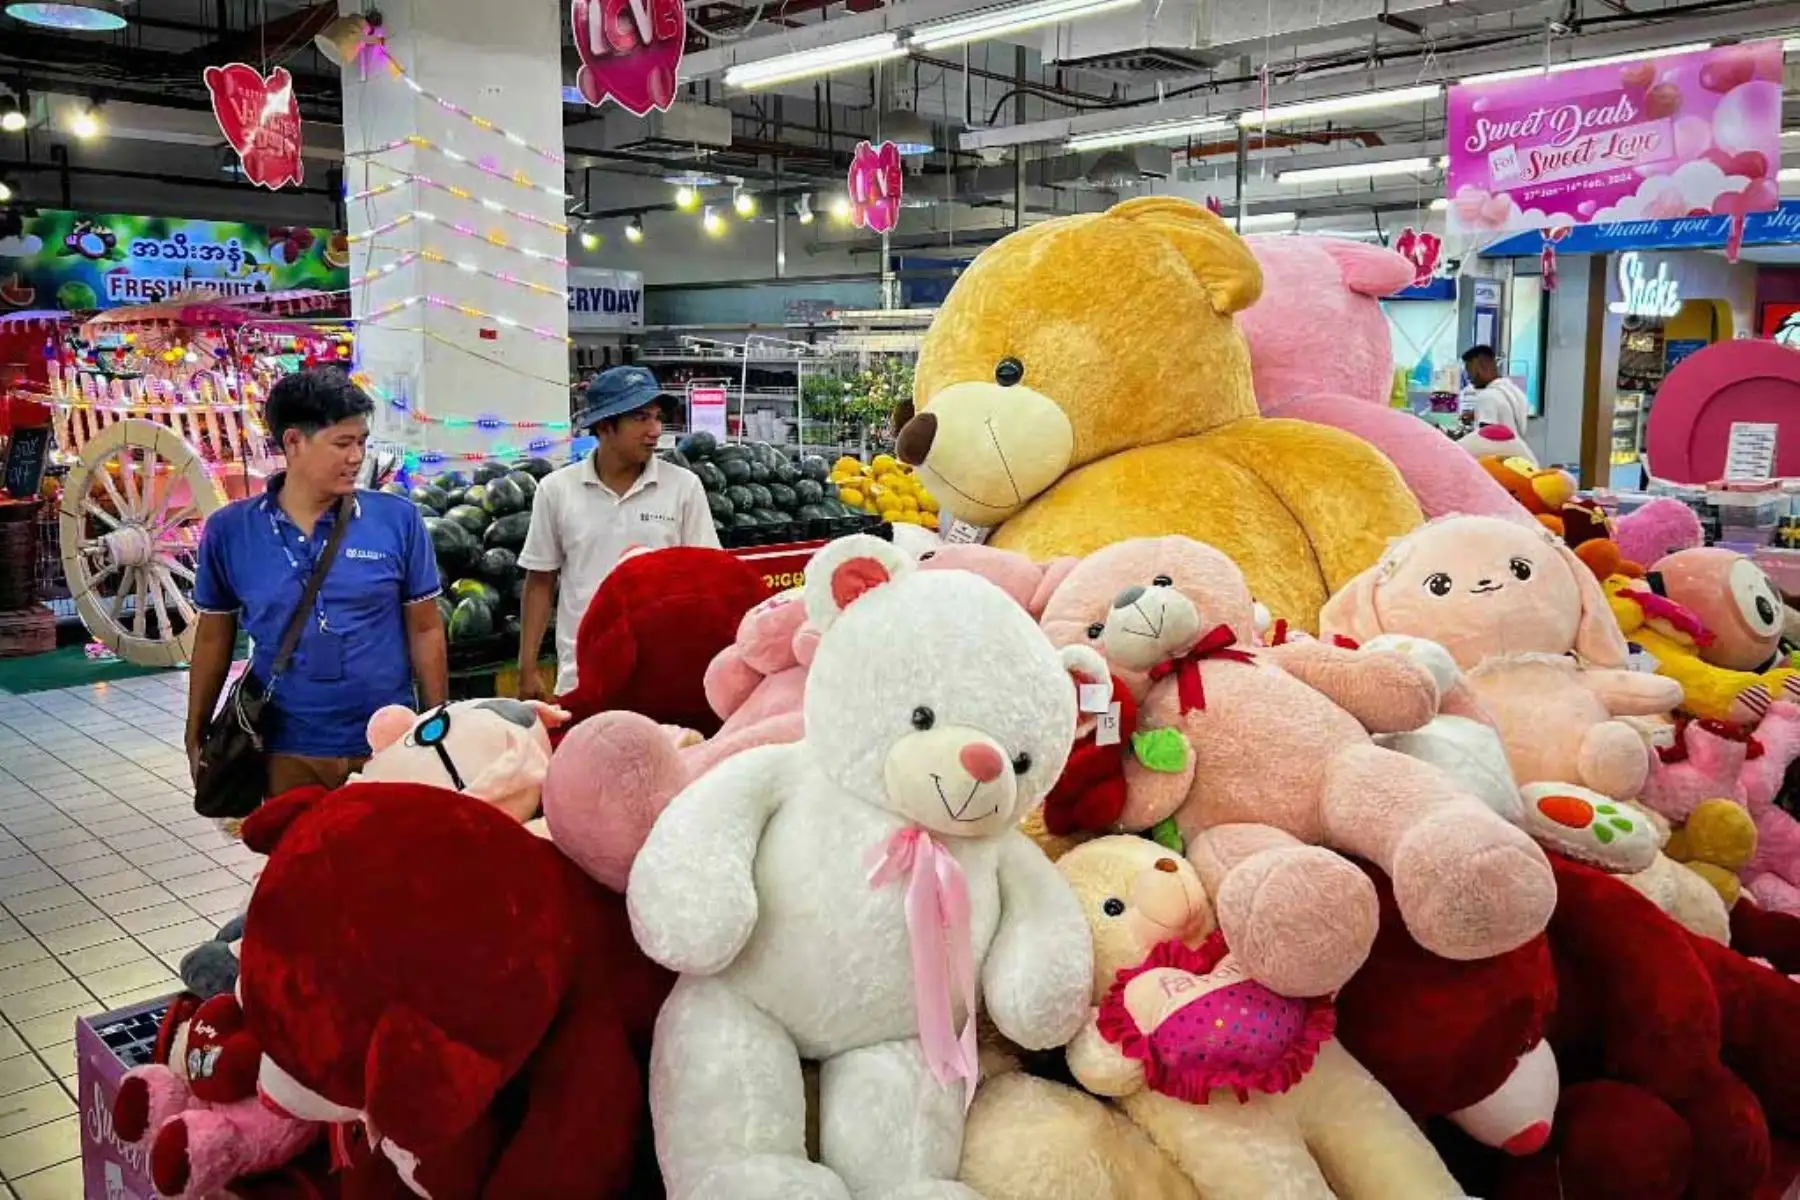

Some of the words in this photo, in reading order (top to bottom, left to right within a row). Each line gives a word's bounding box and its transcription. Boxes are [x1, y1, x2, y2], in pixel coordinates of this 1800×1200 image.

[1465, 108, 1549, 152] Sweet
[1549, 94, 1637, 147] Deals
[1522, 137, 1596, 181] Sweet
[1600, 131, 1660, 160] Love
[1596, 219, 1660, 238] Thank
[1666, 218, 1712, 241] you
[111, 277, 181, 299] FRESH
[1608, 251, 1682, 318] Shake
